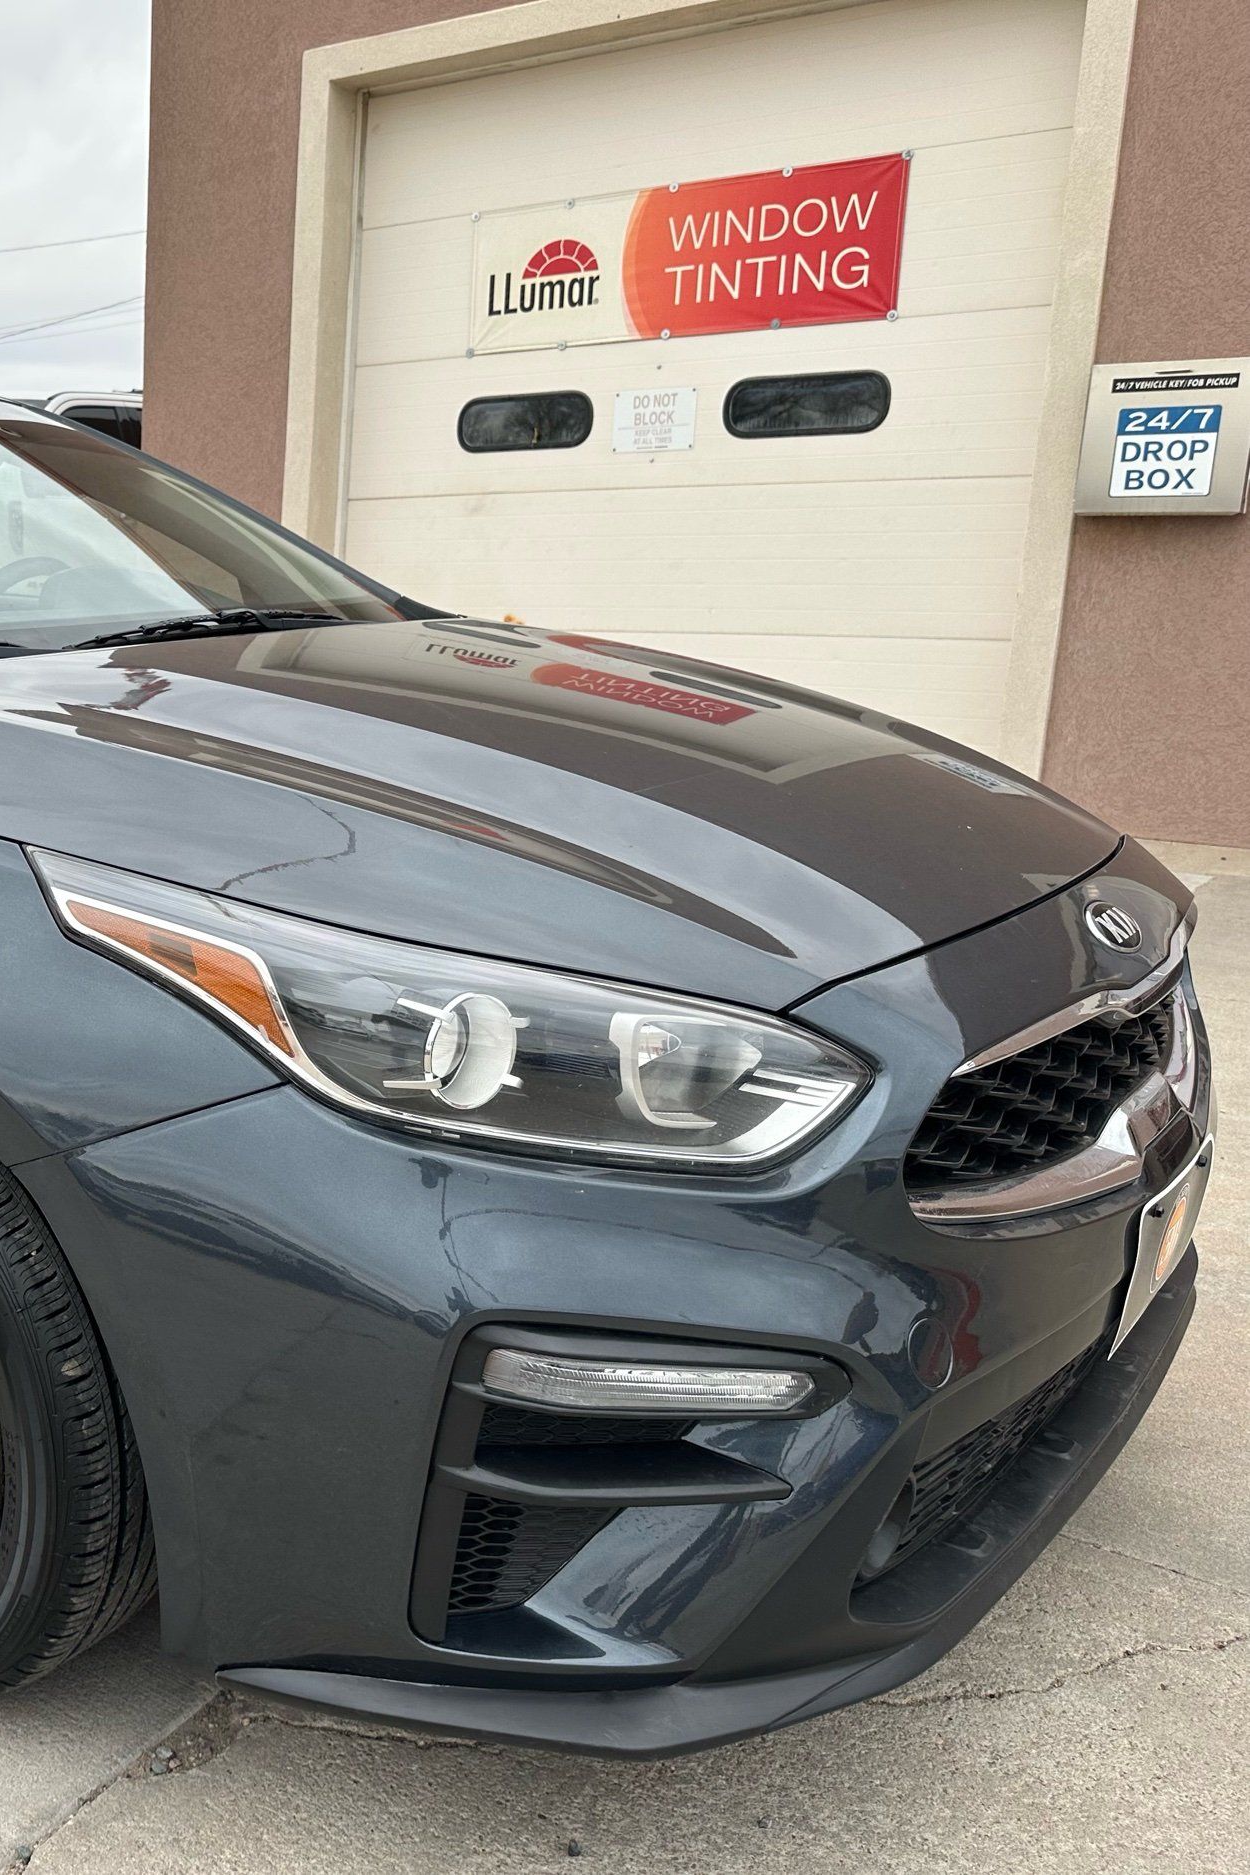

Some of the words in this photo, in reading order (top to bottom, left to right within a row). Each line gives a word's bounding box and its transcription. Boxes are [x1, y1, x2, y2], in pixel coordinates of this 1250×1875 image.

[669, 190, 879, 252] WINDOW
[664, 246, 870, 305] TINTING
[488, 272, 600, 316] LLumar
[1115, 381, 1133, 391] 24/7
[1135, 380, 1168, 390] VEHICLE
[1168, 378, 1205, 388] KEY/FOB
[1206, 377, 1237, 387] PICKUP
[633, 395, 650, 409] DO
[653, 392, 678, 408] NOT
[634, 410, 675, 426] BLOCK
[1125, 408, 1214, 432] 24/7
[1120, 439, 1209, 462] DROP
[1124, 468, 1196, 490] BOX
